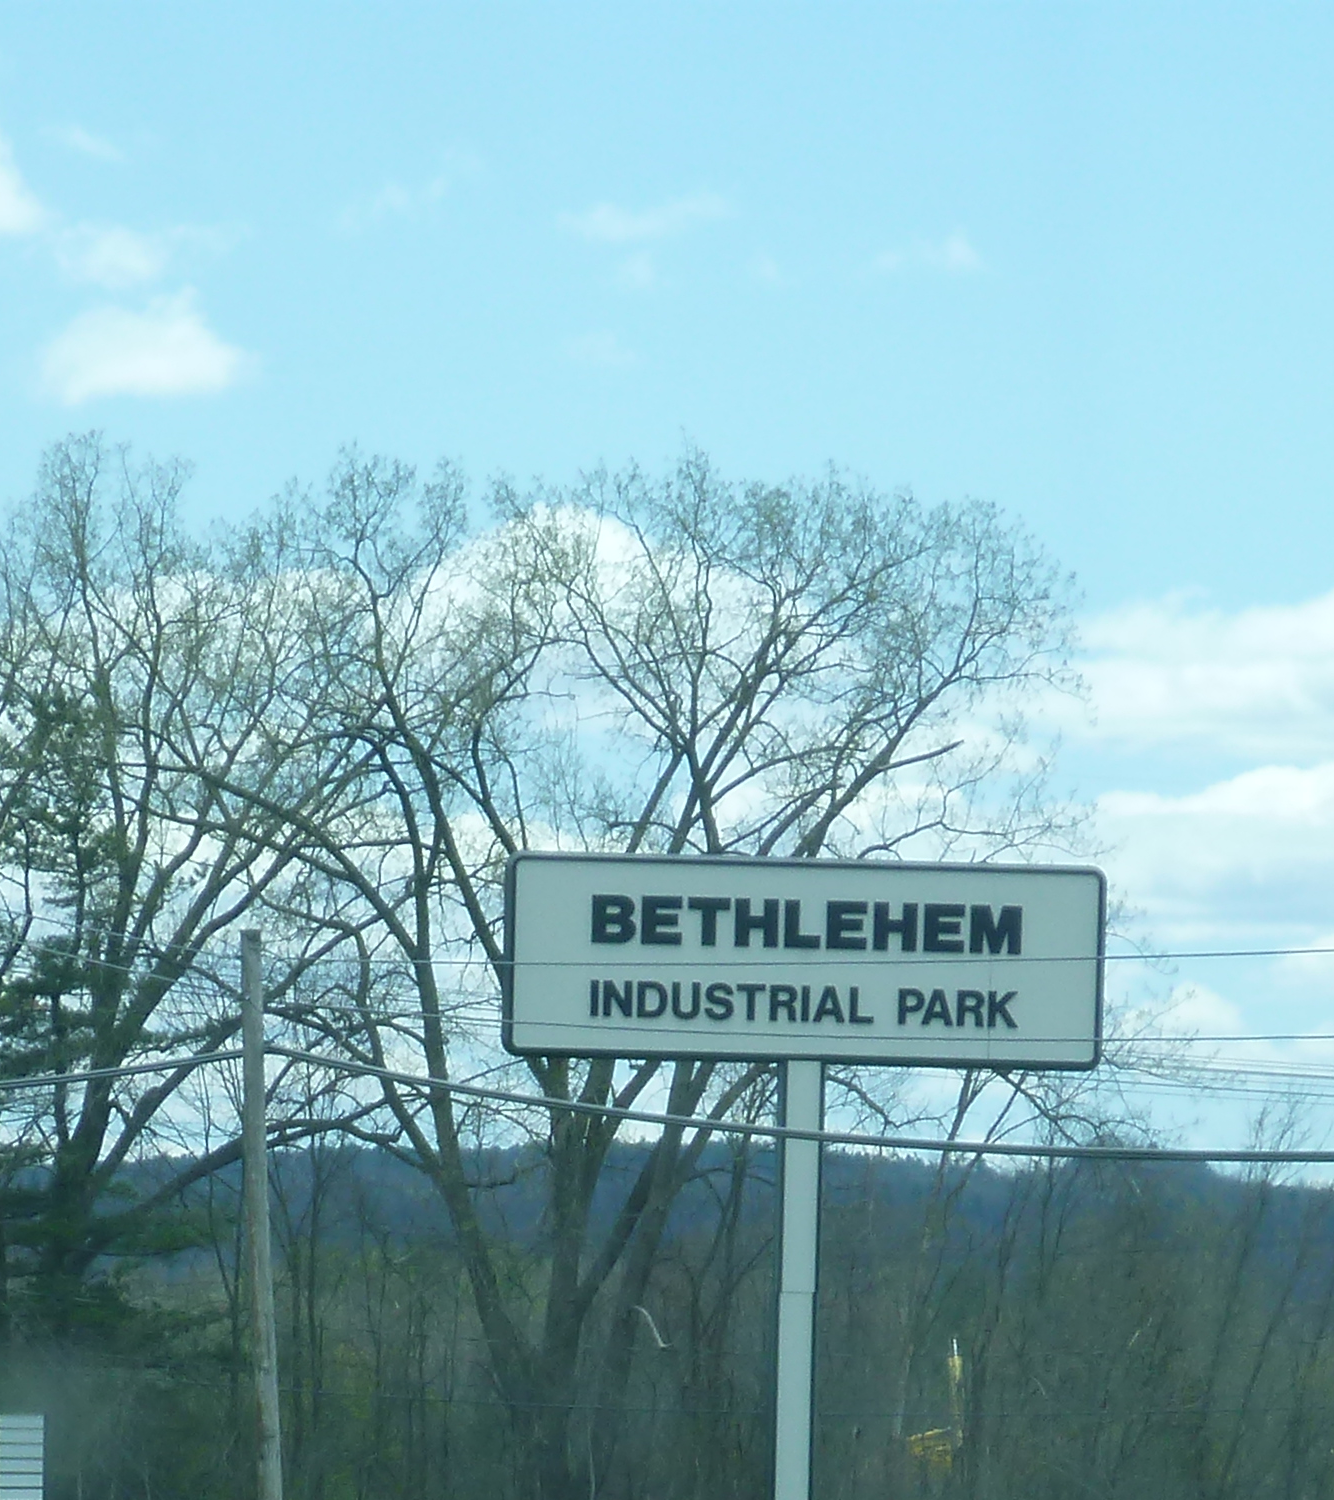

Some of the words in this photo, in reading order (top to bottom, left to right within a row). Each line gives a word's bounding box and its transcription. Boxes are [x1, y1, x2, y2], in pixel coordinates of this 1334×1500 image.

[591, 894, 1023, 954] BETHLEHEM
[590, 979, 874, 1024] INDUSTRIAL
[898, 987, 1018, 1029] PARK
